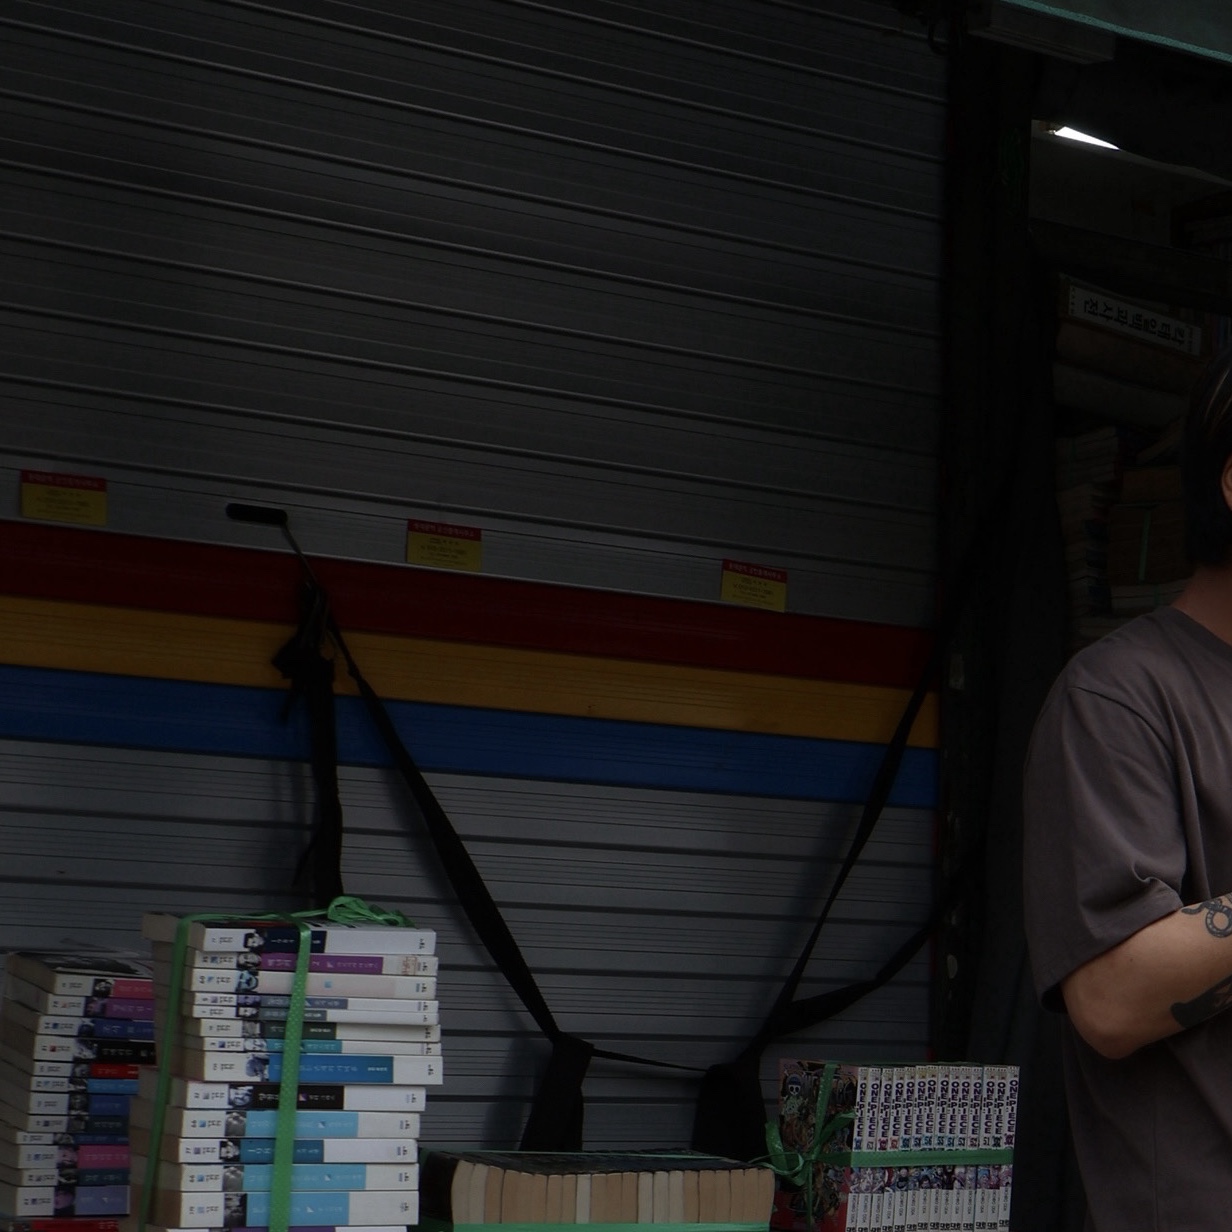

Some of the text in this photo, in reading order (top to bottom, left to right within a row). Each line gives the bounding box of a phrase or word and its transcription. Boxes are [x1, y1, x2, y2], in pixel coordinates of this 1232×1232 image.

[882, 1083, 892, 1138] ONE PIECE
[892, 1082, 904, 1137] ONE PIECE
[904, 1081, 915, 1136] ONE PIECE
[915, 1081, 926, 1135] ONE PIECE
[926, 1079, 936, 1134] ONE PIECE
[938, 1079, 949, 1134] ONE PIECE
[949, 1081, 959, 1135] ONE PIECE
[959, 1081, 970, 1135] ONE PIECE
[971, 1082, 982, 1136] ONE PIECE
[984, 1081, 995, 1135] ONE PIECE
[994, 1082, 1006, 1135] ONE PIECE
[1007, 1079, 1018, 1133] ONE PIECE
